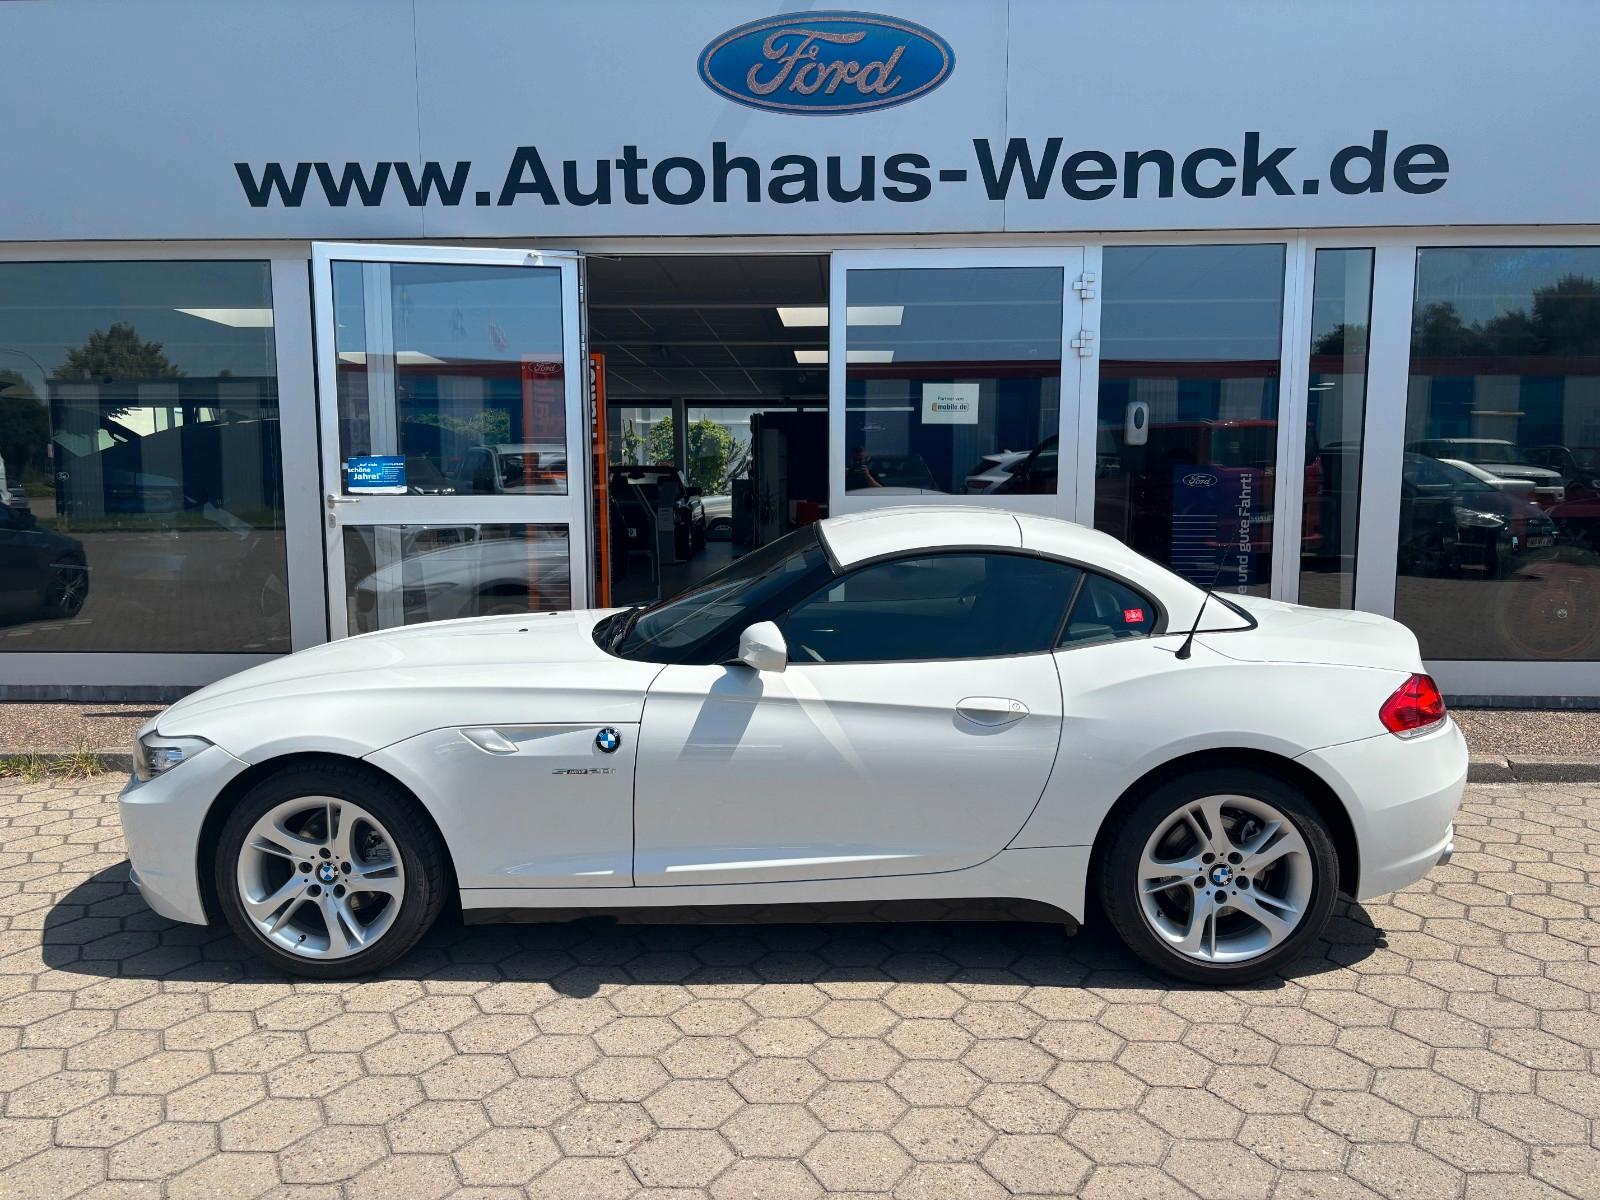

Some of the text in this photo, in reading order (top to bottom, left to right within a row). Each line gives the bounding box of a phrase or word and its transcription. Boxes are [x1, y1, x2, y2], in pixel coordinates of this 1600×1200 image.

[746, 29, 906, 95] Ford
[234, 129, 1450, 208] www.Autohaus-Wenck.de
[1239, 519, 1251, 552] gute
[1236, 555, 1249, 583] und
